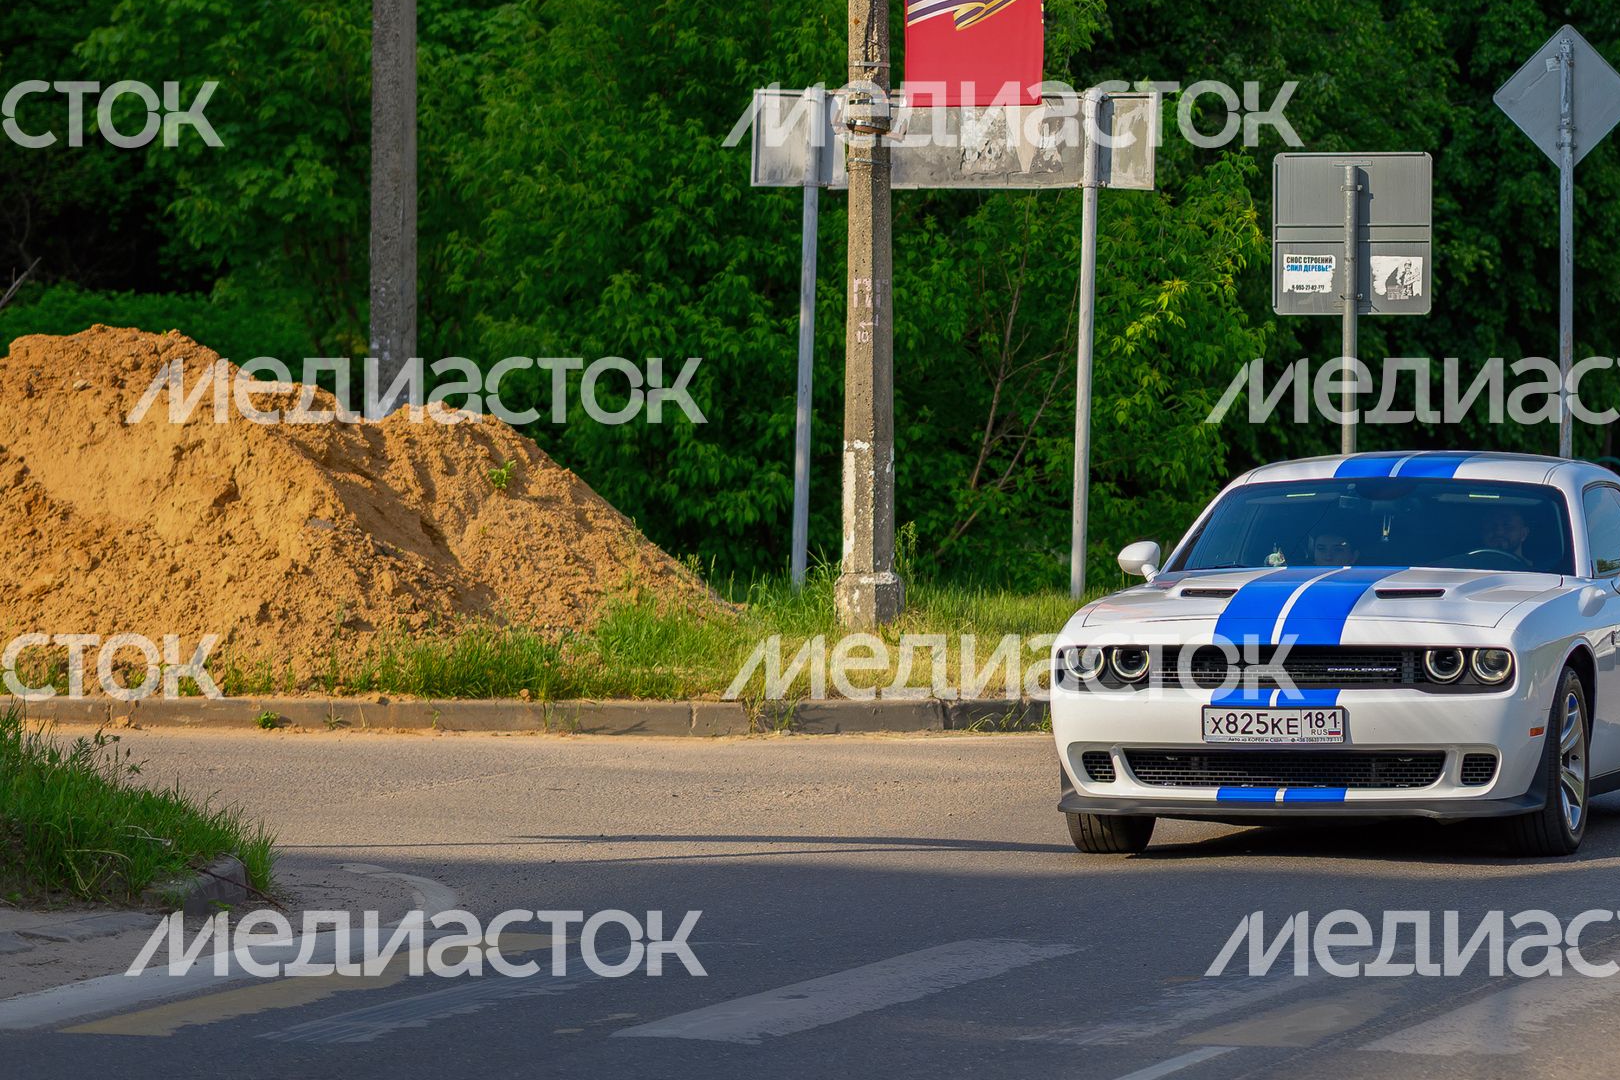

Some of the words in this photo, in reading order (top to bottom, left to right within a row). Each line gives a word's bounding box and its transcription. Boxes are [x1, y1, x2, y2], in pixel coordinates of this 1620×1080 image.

[1286, 256, 1302, 264] СНОС
[1211, 712, 1299, 735] Х825КЕ
[1303, 711, 1338, 729] 181
